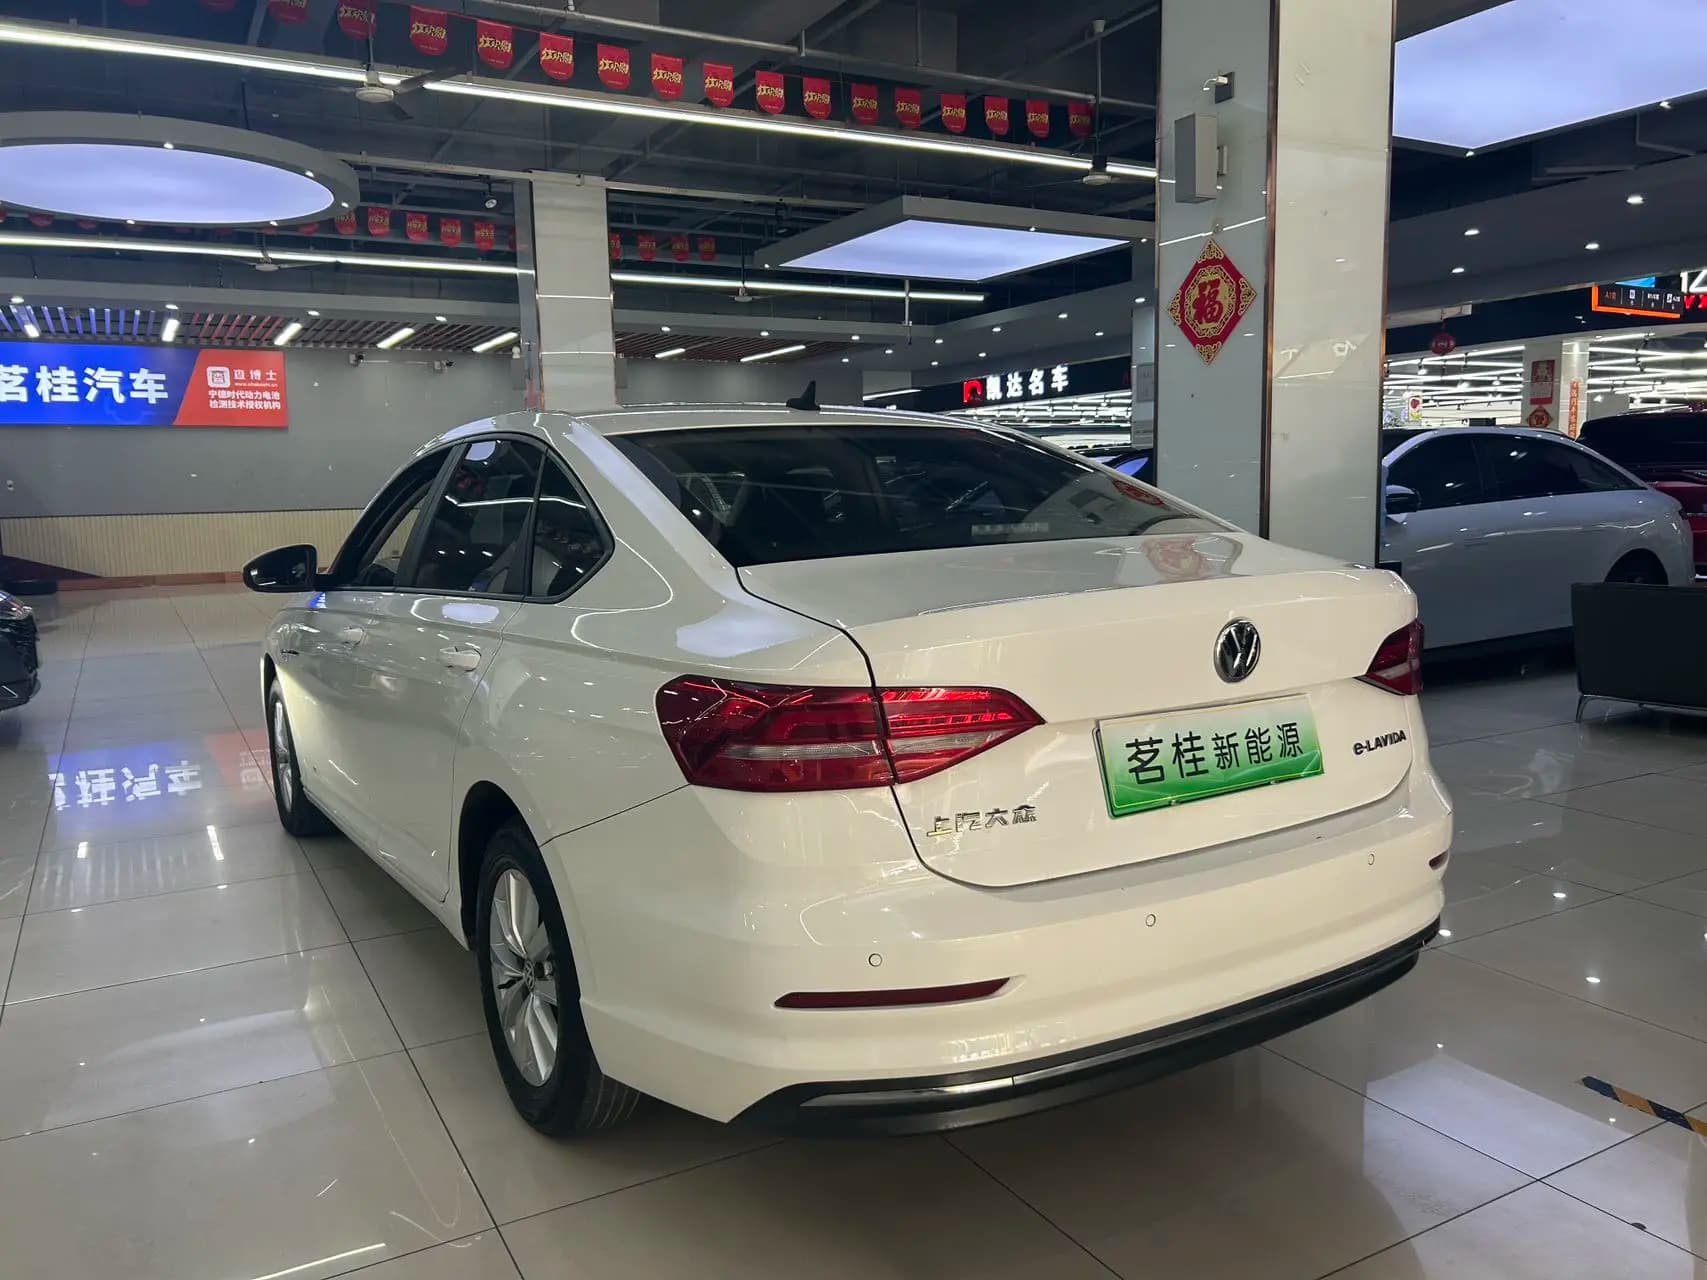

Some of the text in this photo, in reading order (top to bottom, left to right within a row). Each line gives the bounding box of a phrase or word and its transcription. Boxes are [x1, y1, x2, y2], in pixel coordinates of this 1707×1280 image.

[1192, 278, 1224, 324] 福
[0, 364, 169, 404] 茗桂汽车
[208, 390, 280, 400] 宁德时代动力电池
[209, 400, 281, 409] 检测技术授权机构
[1125, 722, 1304, 786] 茗桂新能源
[1353, 729, 1407, 756] e-LAVIDA
